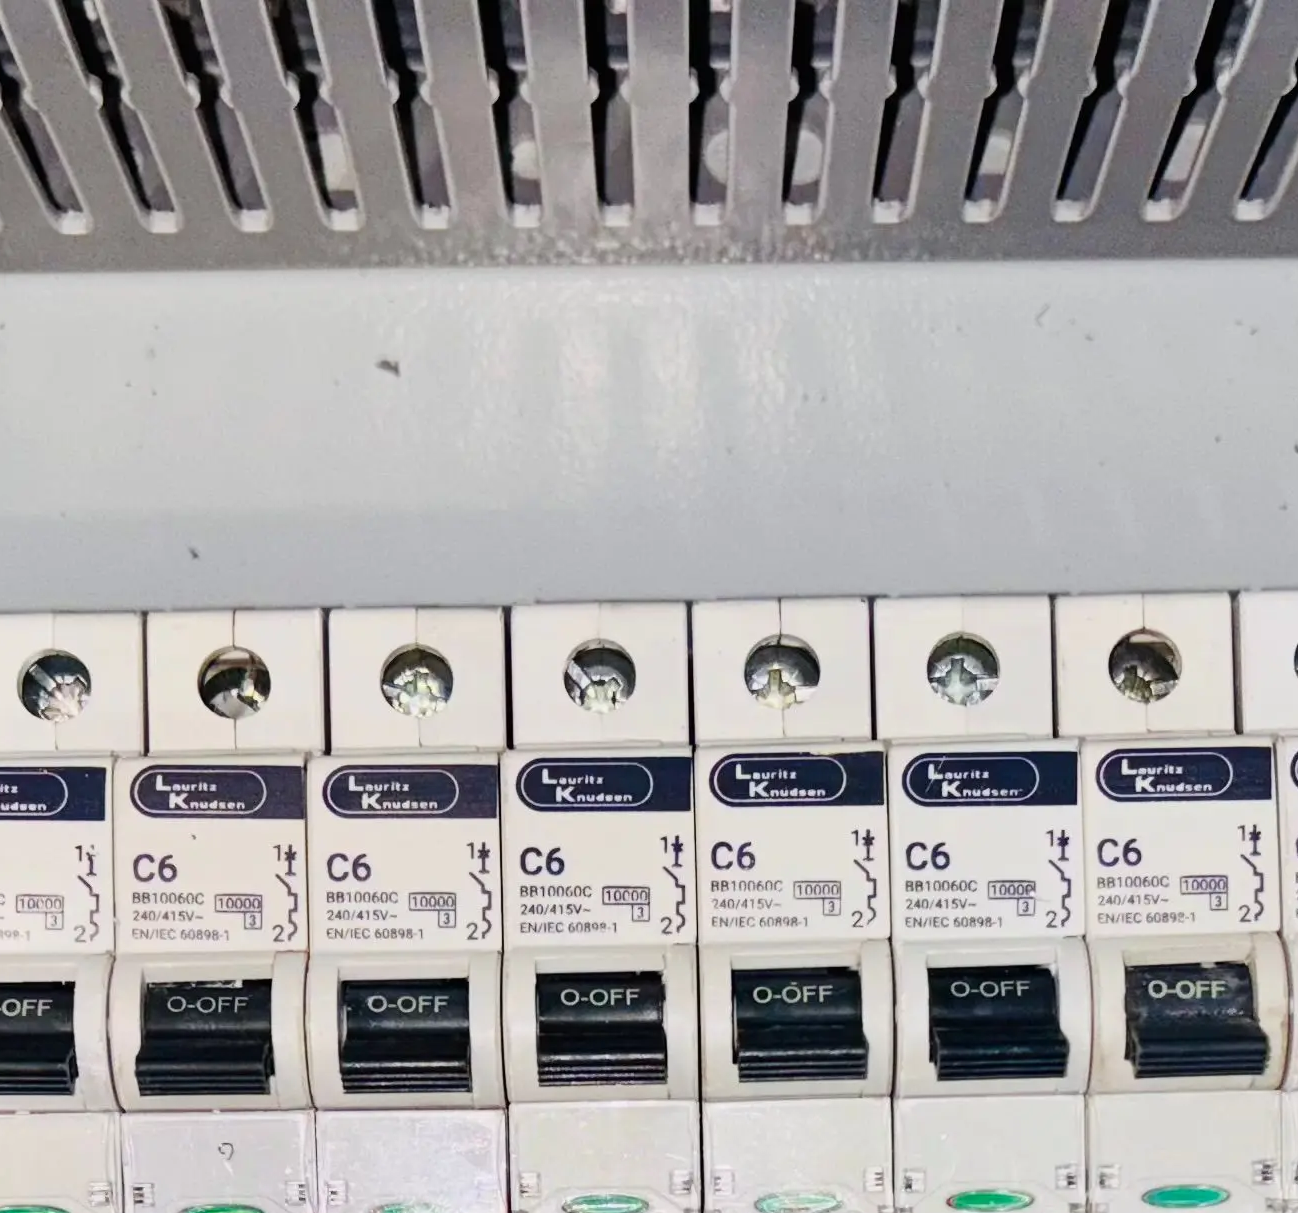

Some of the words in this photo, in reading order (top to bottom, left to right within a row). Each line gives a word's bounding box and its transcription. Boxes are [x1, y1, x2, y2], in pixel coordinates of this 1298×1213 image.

[711, 842, 755, 870] C6
[906, 842, 950, 870] C6
[1097, 839, 1141, 867] C6
[327, 853, 371, 881] C6
[520, 847, 564, 875] C6
[133, 854, 177, 882] C6
[711, 880, 782, 892] BB10060C
[906, 880, 977, 892] BB10060C
[1097, 876, 1169, 888] BB10060C
[1185, 881, 1226, 892] 10000
[520, 886, 592, 897] BB10060C
[607, 890, 649, 901] 10000
[798, 885, 839, 895] 10000
[20, 898, 62, 909] 10000
[133, 892, 204, 904] BB10060C
[220, 898, 261, 908] 10000
[327, 892, 398, 903] BB10060C
[413, 896, 455, 907] 10000
[327, 928, 370, 939] EN/IEC
[375, 928, 422, 939] 60898-1
[753, 983, 833, 1003] O-OFF
[951, 981, 1029, 997] O-OFF
[1148, 978, 1227, 999] O-OFF
[561, 989, 639, 1005] O-OFF
[167, 996, 248, 1013] O-OFF
[367, 996, 448, 1012] O-OFF
